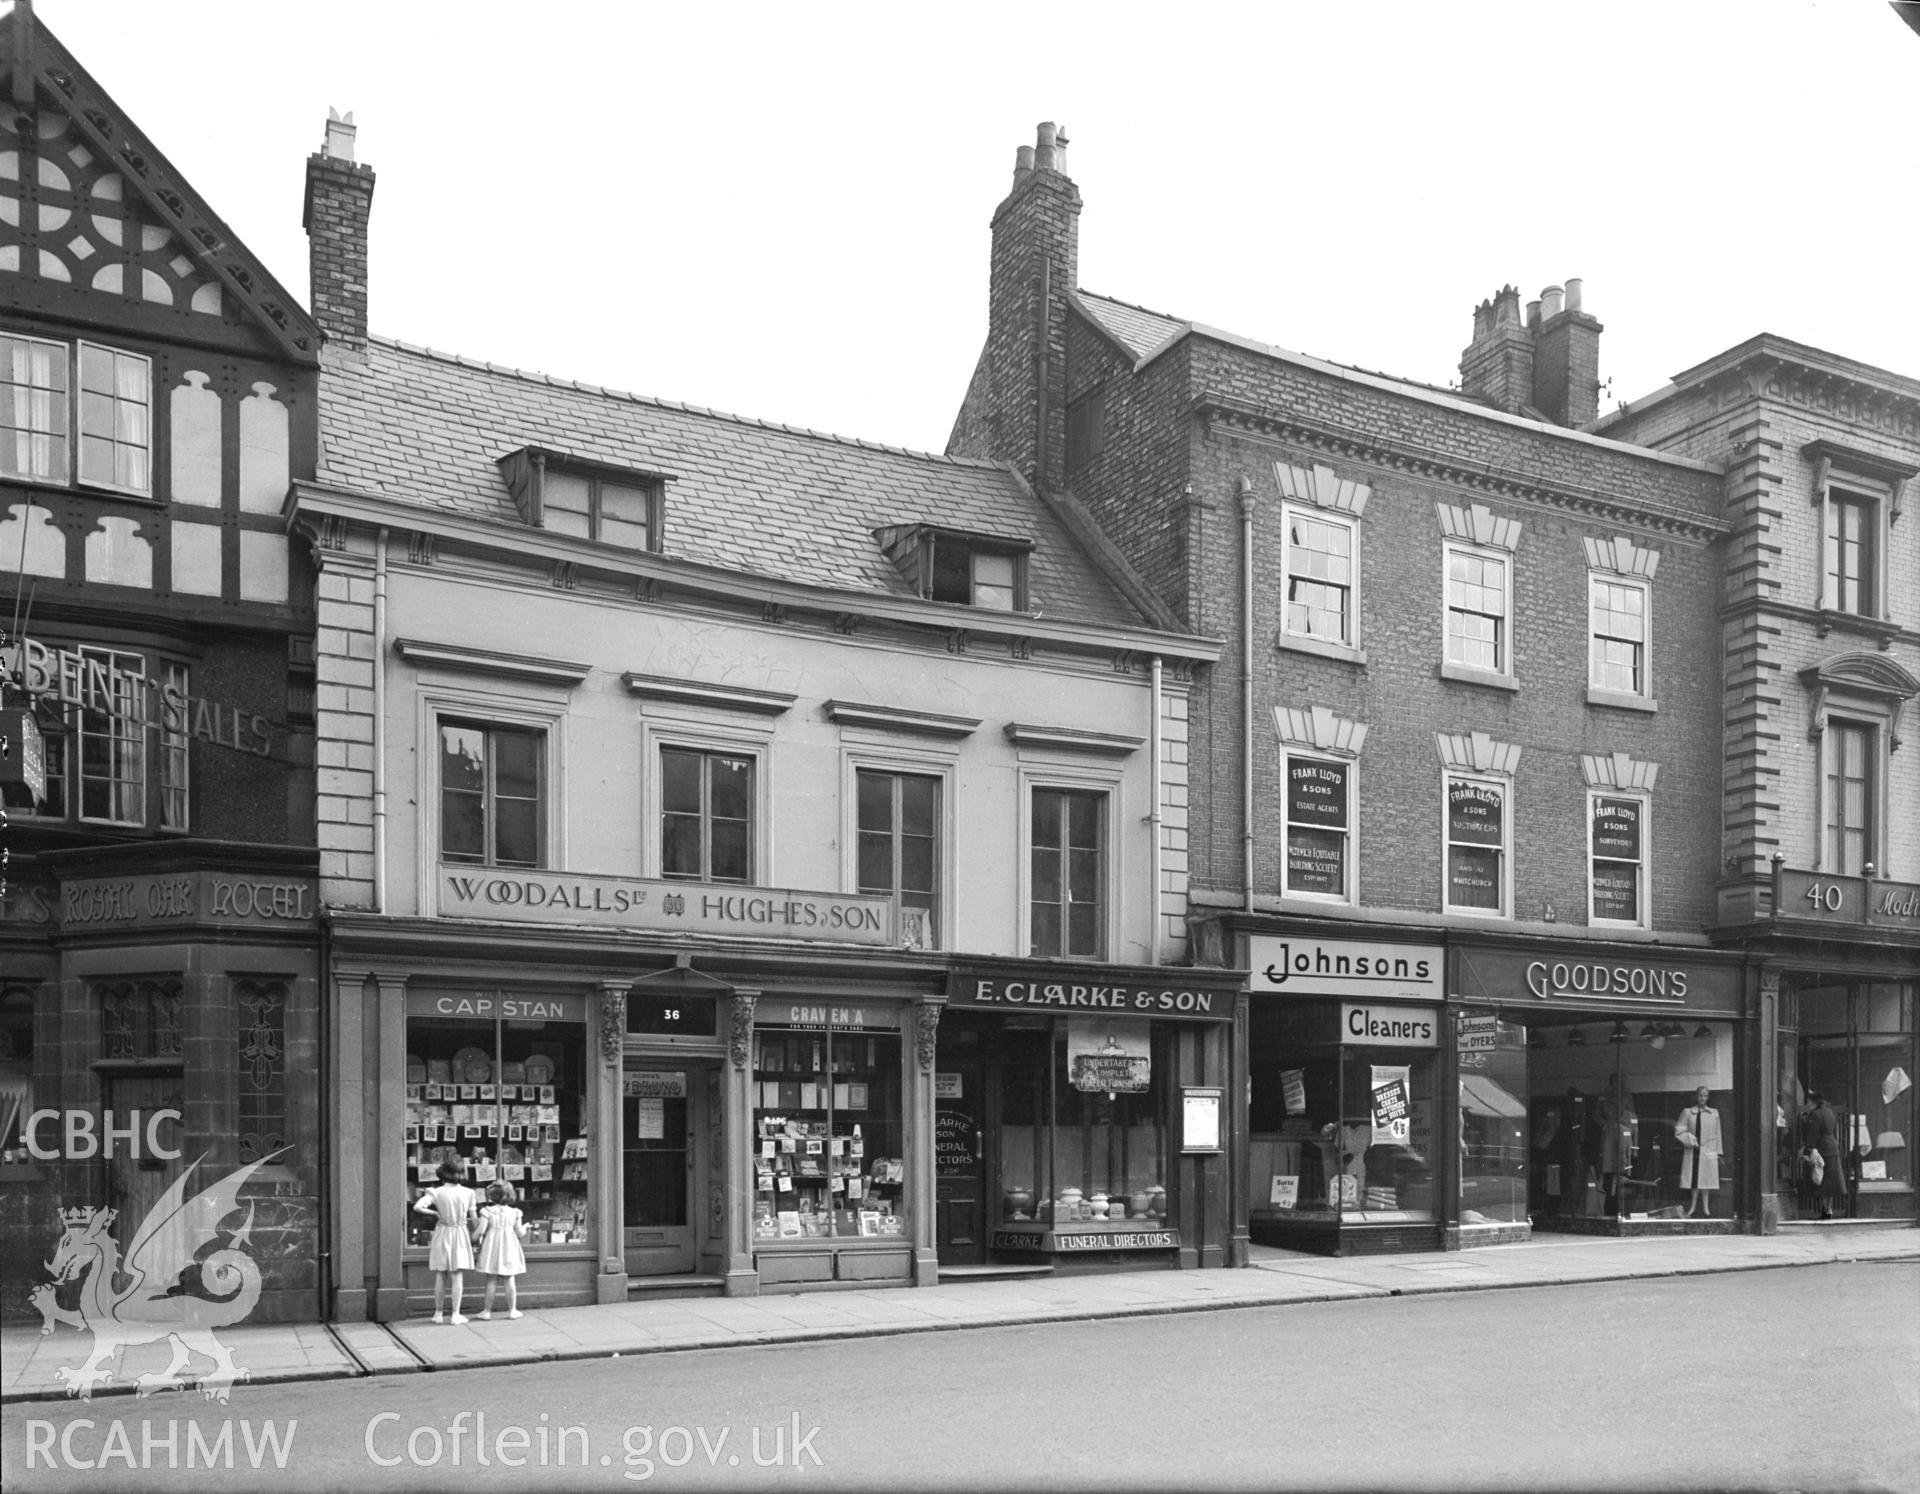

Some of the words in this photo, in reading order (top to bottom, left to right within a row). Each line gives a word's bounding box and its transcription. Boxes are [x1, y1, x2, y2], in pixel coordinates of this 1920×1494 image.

[192, 698, 270, 757] ALES
[1292, 767, 1317, 780] FRANK
[1319, 768, 1342, 785] LLOYD
[1309, 785, 1332, 795] SONS
[1450, 789, 1476, 803] FRANK
[1476, 789, 1500, 808] LLOYD
[1296, 801, 1315, 811] ESTATE
[1317, 803, 1339, 813] AGENTS
[1469, 807, 1487, 816] SONS
[1595, 806, 1616, 818] FRANK
[1618, 807, 1636, 821] LLOYD
[1609, 822, 1628, 831] SONS
[1315, 862, 1338, 874] SOCIETY
[1458, 865, 1473, 873] AND
[1453, 877, 1493, 888] WHITCHURCH
[147, 880, 194, 919] OAK
[447, 876, 631, 913] WOODALLS
[665, 899, 683, 912] 36
[701, 894, 818, 928] HUGHES
[830, 904, 881, 931] SON
[1807, 883, 1843, 912] 40
[1265, 943, 1430, 984] Johnsons
[1526, 961, 1688, 998] GOODSON'S
[436, 997, 565, 1018] CAPSTAN
[1134, 991, 1155, 1009] &
[1158, 991, 1213, 1012] SON
[663, 1009, 681, 1020] 36
[790, 1006, 849, 1024] CRAVEN
[1348, 1009, 1432, 1040] Cleaners
[1458, 1019, 1496, 1037] Johnsons
[1470, 1036, 1496, 1048] DYERS
[631, 1080, 682, 1096] BRUNO
[1375, 1086, 1402, 1103] DRESSES
[1376, 1100, 1406, 1117] COSTUMES
[1380, 1095, 1398, 1108] COATS
[1388, 1107, 1406, 1120] SUITS
[1060, 1235, 1112, 1249] FUNERAL
[1113, 1232, 1172, 1248] DIRECTORS
